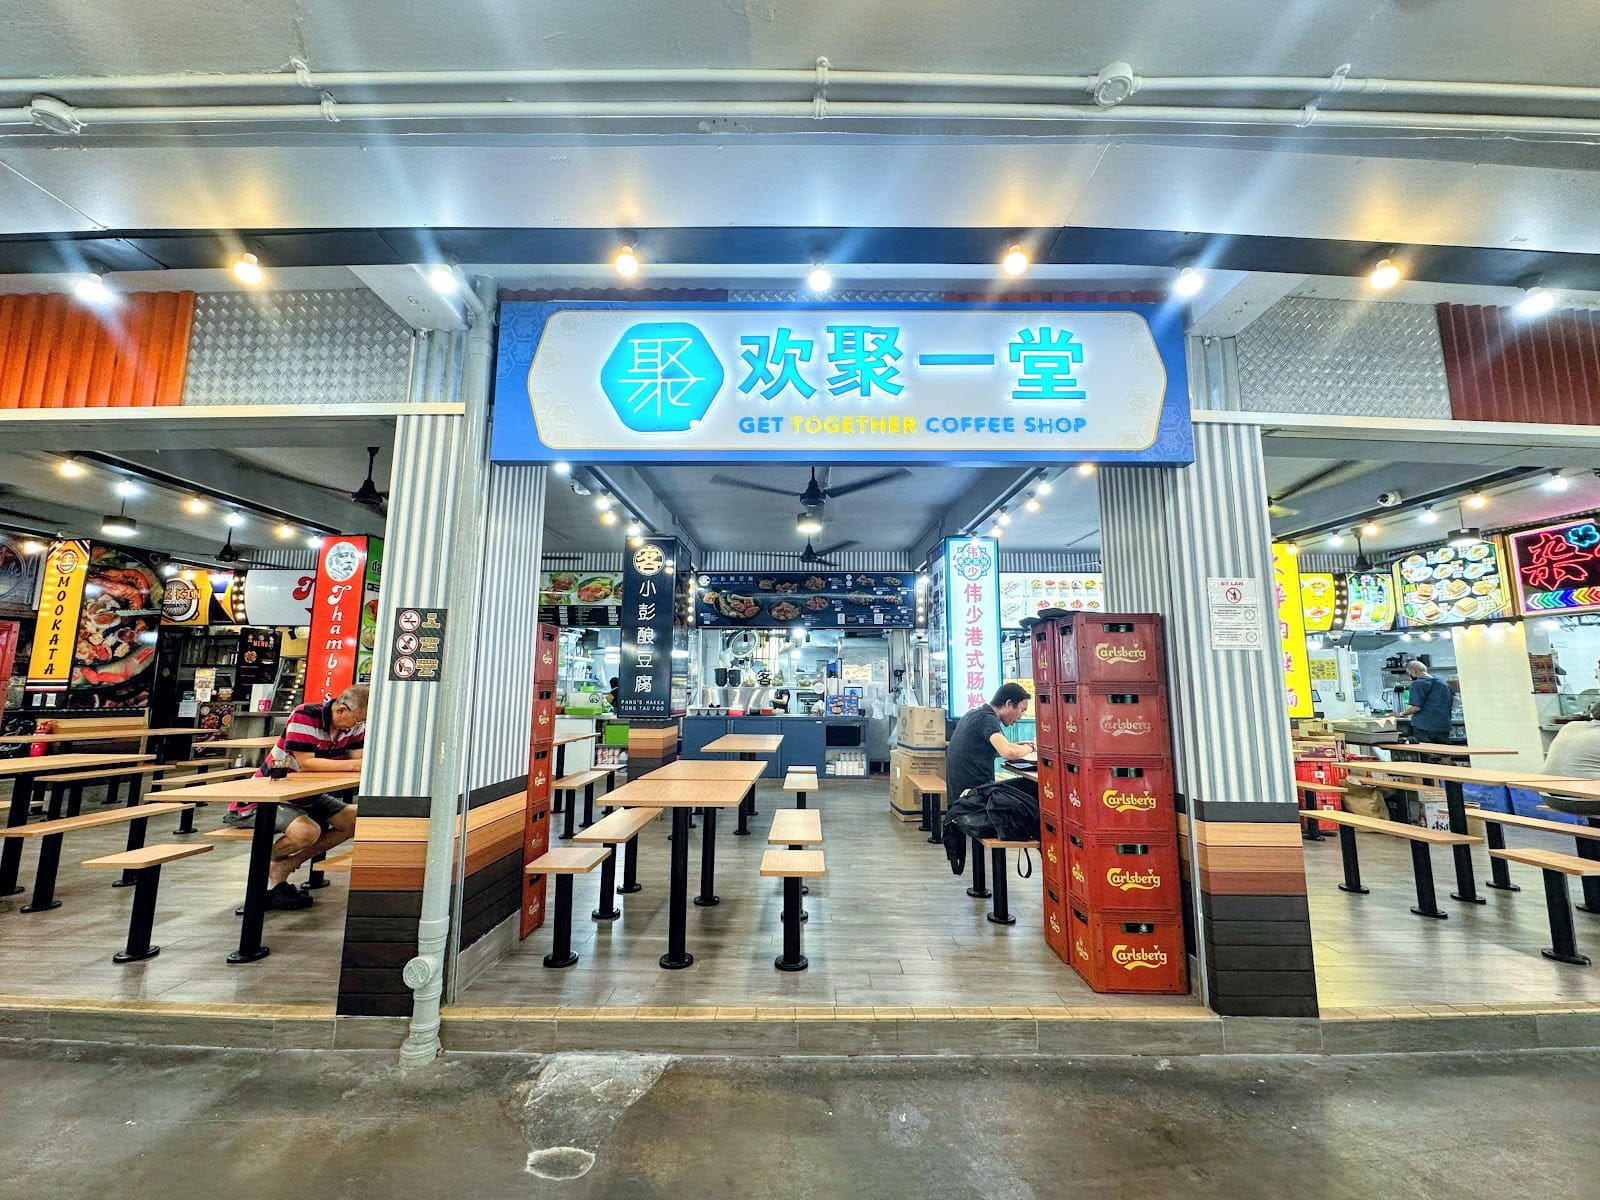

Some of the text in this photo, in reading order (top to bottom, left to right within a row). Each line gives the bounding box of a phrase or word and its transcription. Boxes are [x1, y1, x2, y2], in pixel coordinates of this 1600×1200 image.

[736, 324, 1087, 401] 欢聚一堂
[617, 336, 707, 418] 聚
[738, 416, 1087, 434] GET TOGETHER COFFEE SHOP
[176, 588, 202, 600] KIN
[44, 575, 71, 675] MOOKATA
[634, 579, 658, 693] 小彭酿豆腐
[321, 584, 353, 703] Thambi's
[963, 582, 986, 709] 伟少港式肠粉
[1095, 643, 1147, 664] Carlsberg
[1100, 714, 1151, 736] Carlsberg
[1102, 789, 1157, 812] Carlsberg
[1106, 867, 1161, 891] Carlsberg
[1111, 944, 1168, 970] Carlsberg
